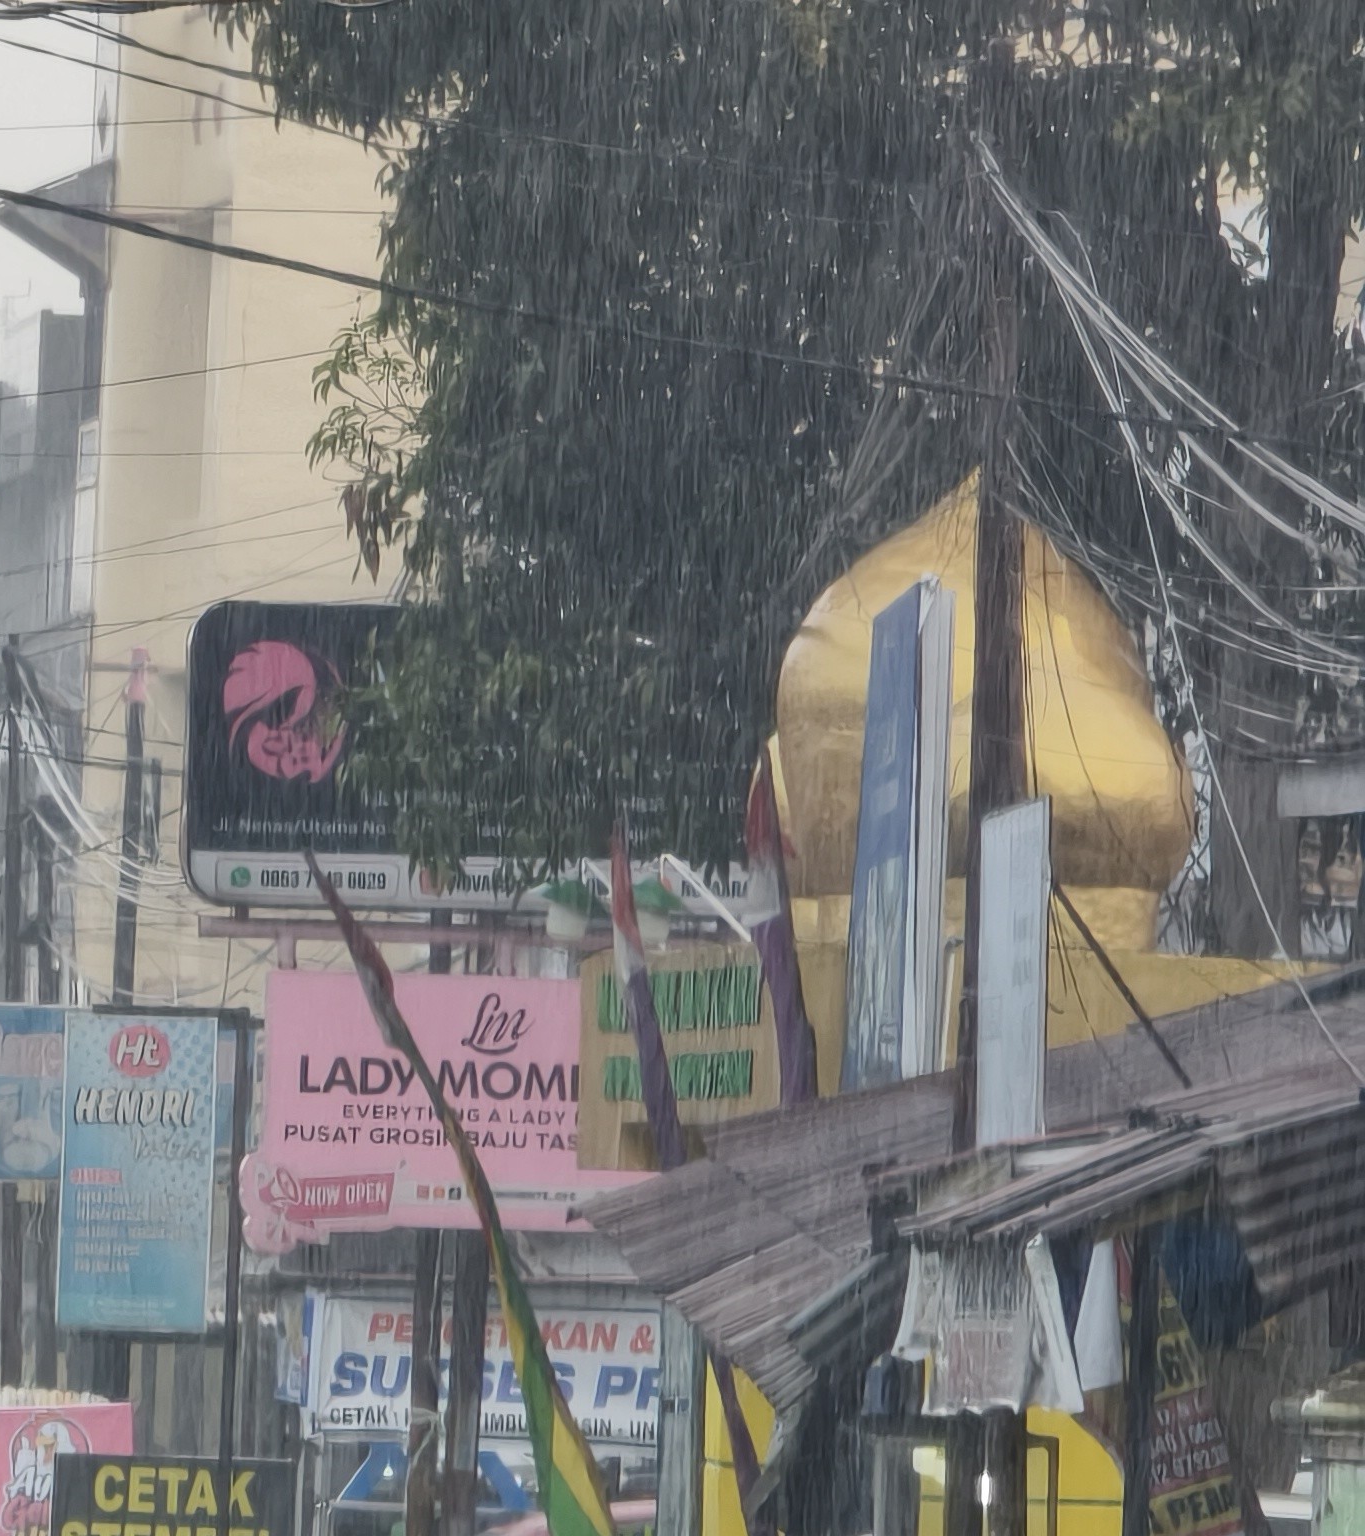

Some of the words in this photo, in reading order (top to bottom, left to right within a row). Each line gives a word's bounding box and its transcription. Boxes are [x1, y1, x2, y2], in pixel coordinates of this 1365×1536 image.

[299, 1054, 415, 1097] LADY
[74, 1085, 195, 1128] HENDRI
[488, 1108, 501, 1123] A
[509, 1108, 565, 1126] LADY
[283, 1124, 362, 1146] PUSAT
[305, 1185, 340, 1206] NOW
[345, 1180, 387, 1205] OPEN
[629, 1324, 655, 1354] &
[330, 1406, 389, 1427] CETAK
[93, 1464, 256, 1518] CETAK
